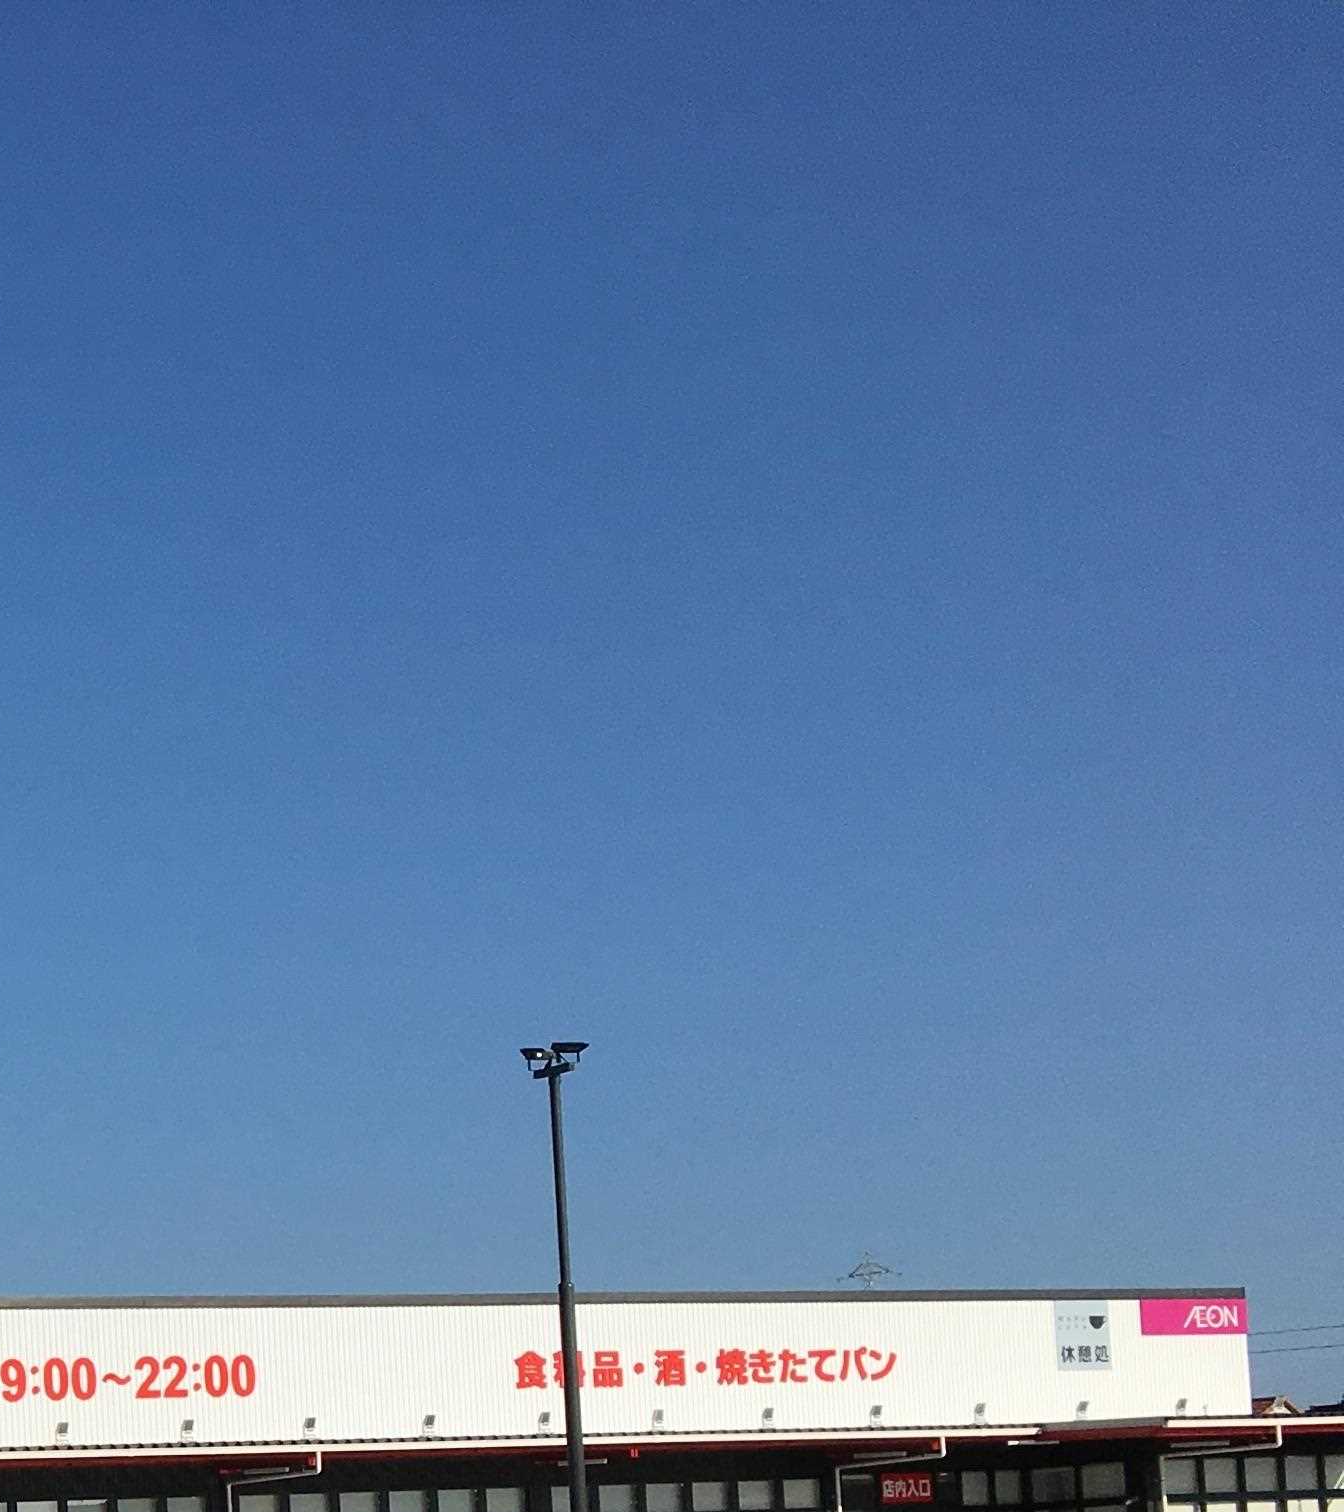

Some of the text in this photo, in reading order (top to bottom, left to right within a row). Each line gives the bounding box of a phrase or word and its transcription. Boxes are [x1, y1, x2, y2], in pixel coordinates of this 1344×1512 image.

[1061, 1345, 1110, 1363] 休憩処
[882, 1479, 931, 1498] 店内入口
